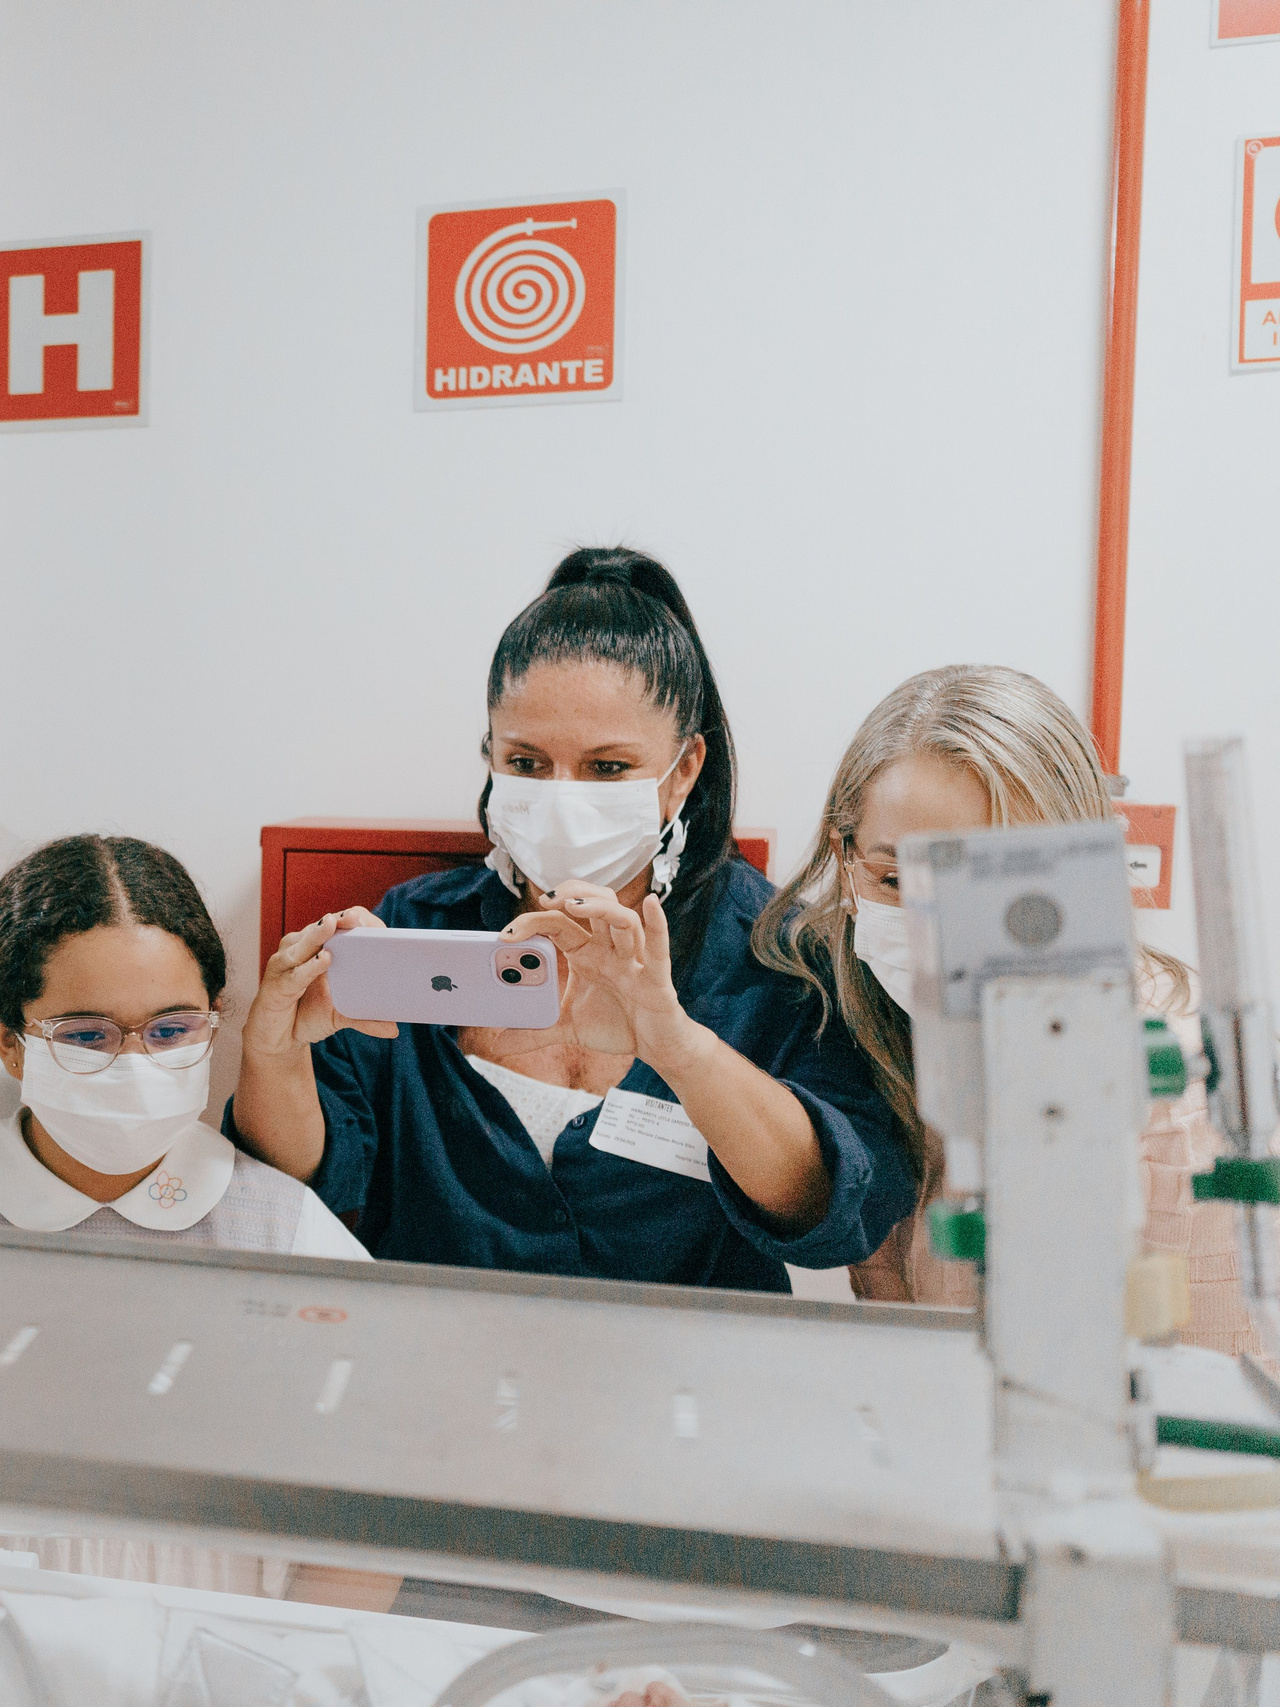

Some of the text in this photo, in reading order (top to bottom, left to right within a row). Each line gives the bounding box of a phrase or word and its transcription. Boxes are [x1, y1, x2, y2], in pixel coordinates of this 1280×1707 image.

[8, 269, 115, 396] H
[434, 359, 605, 392] HIDRANTE
[645, 1098, 673, 1114] VISITANTES
